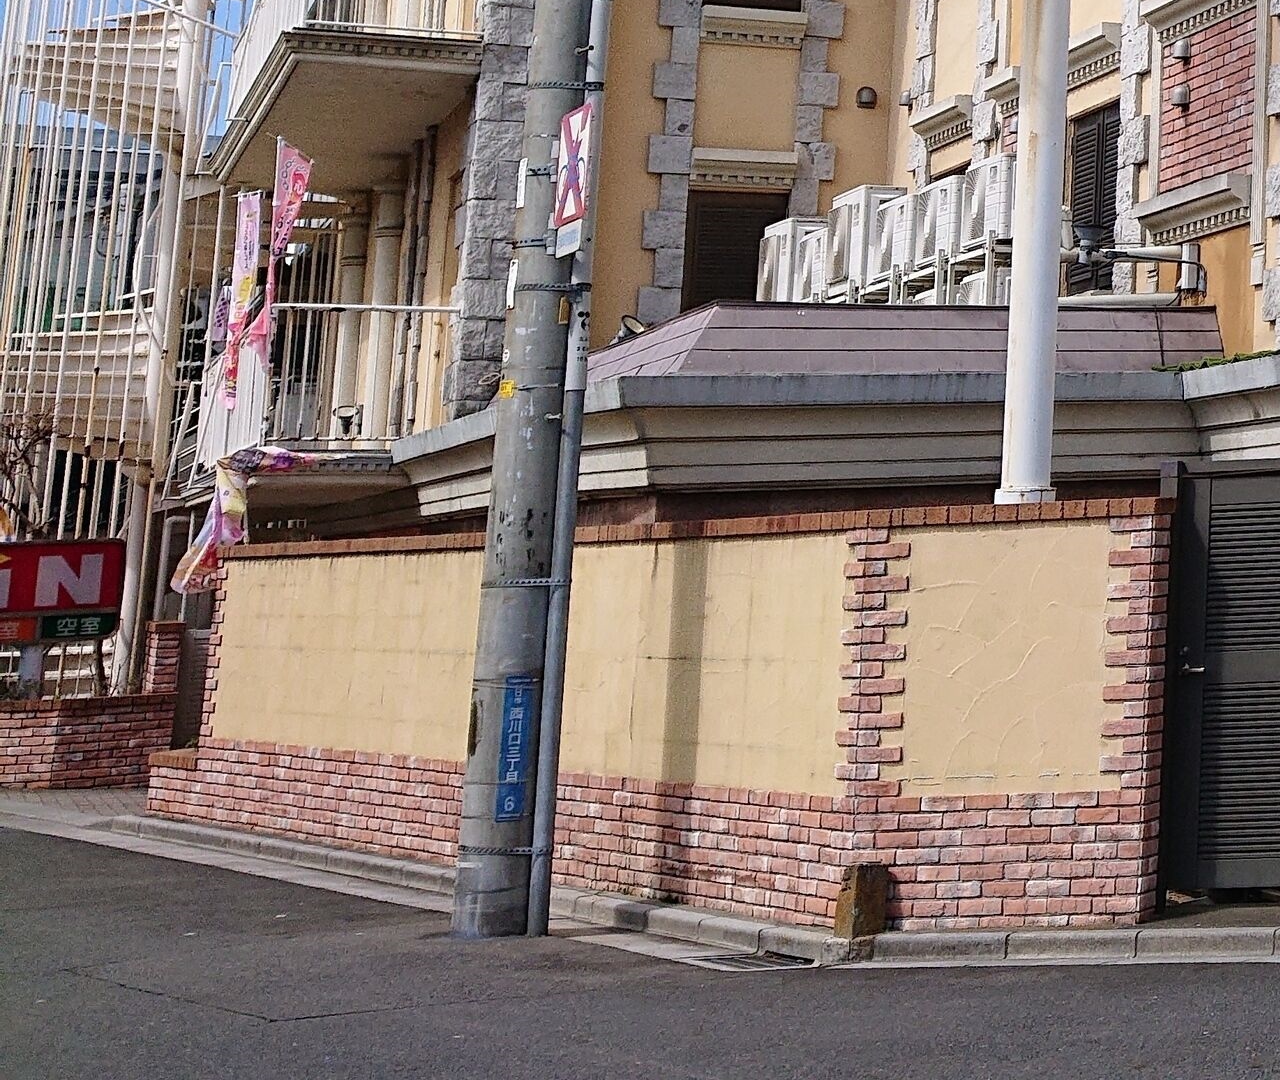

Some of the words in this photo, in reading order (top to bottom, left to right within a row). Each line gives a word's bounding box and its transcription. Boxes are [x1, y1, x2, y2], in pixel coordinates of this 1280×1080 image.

[55, 616, 101, 637] 空室
[505, 707, 524, 785] 西川口三丁目
[504, 797, 515, 812] 6
